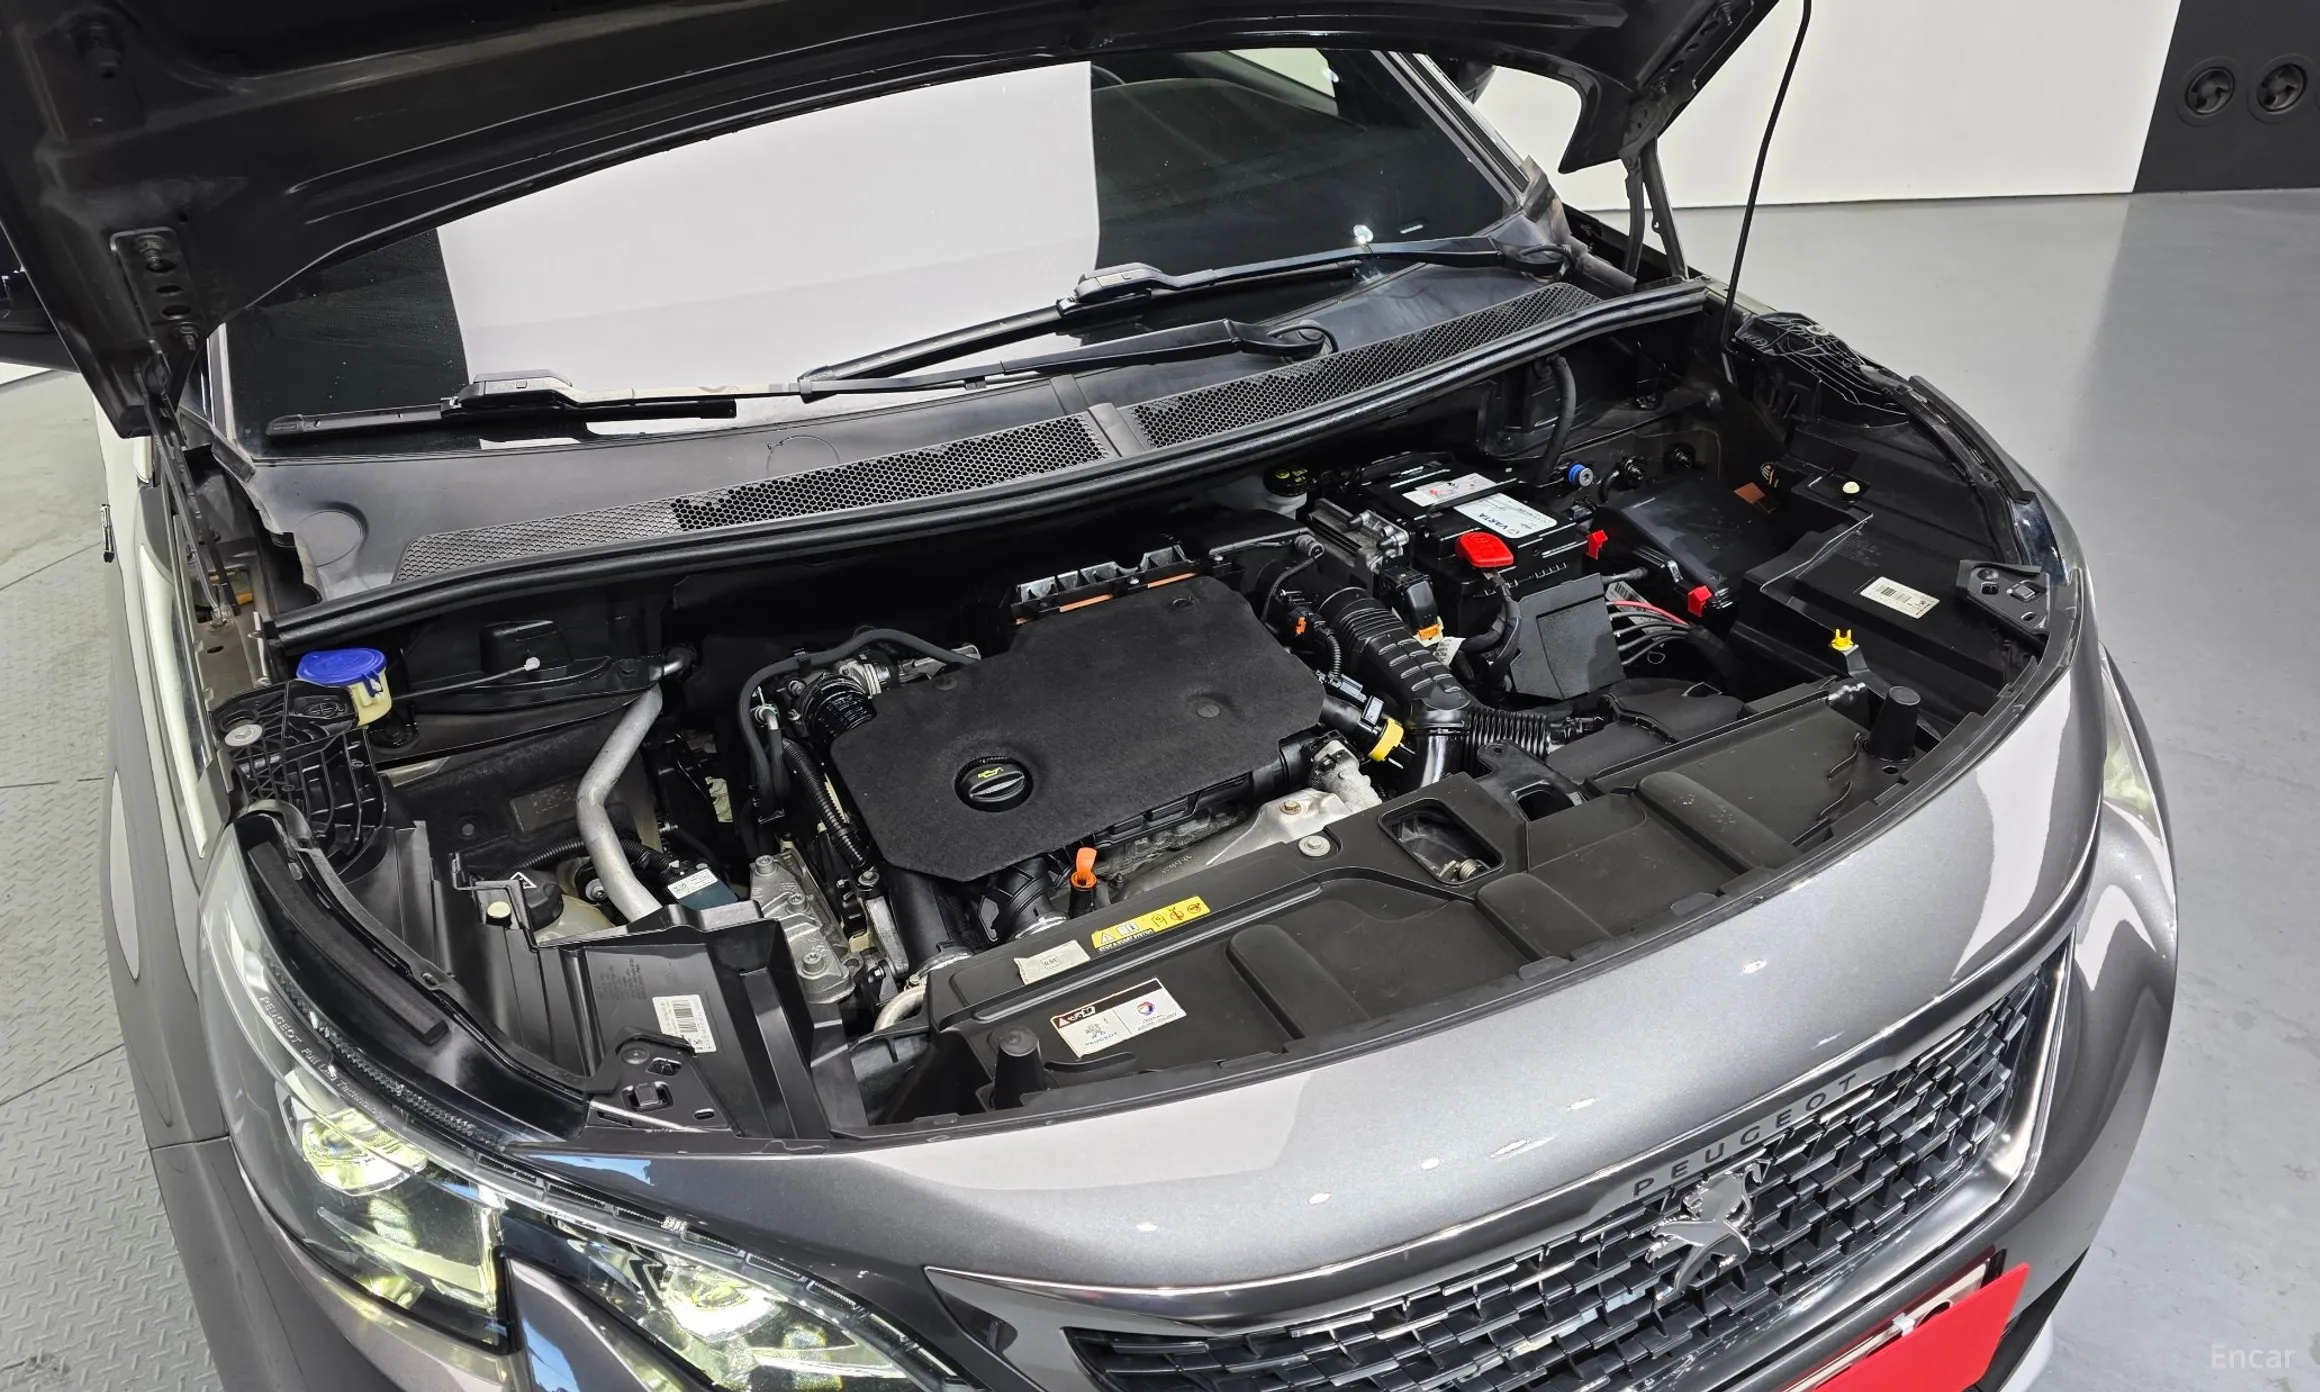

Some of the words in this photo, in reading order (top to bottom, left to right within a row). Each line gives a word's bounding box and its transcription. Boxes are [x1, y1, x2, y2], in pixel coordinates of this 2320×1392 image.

[1479, 512, 1508, 529] VARTA
[260, 996, 302, 1044] PEUGEOT
[1084, 1031, 1118, 1046] PEUGEOT
[1633, 1074, 1857, 1197] PEUGEOT
